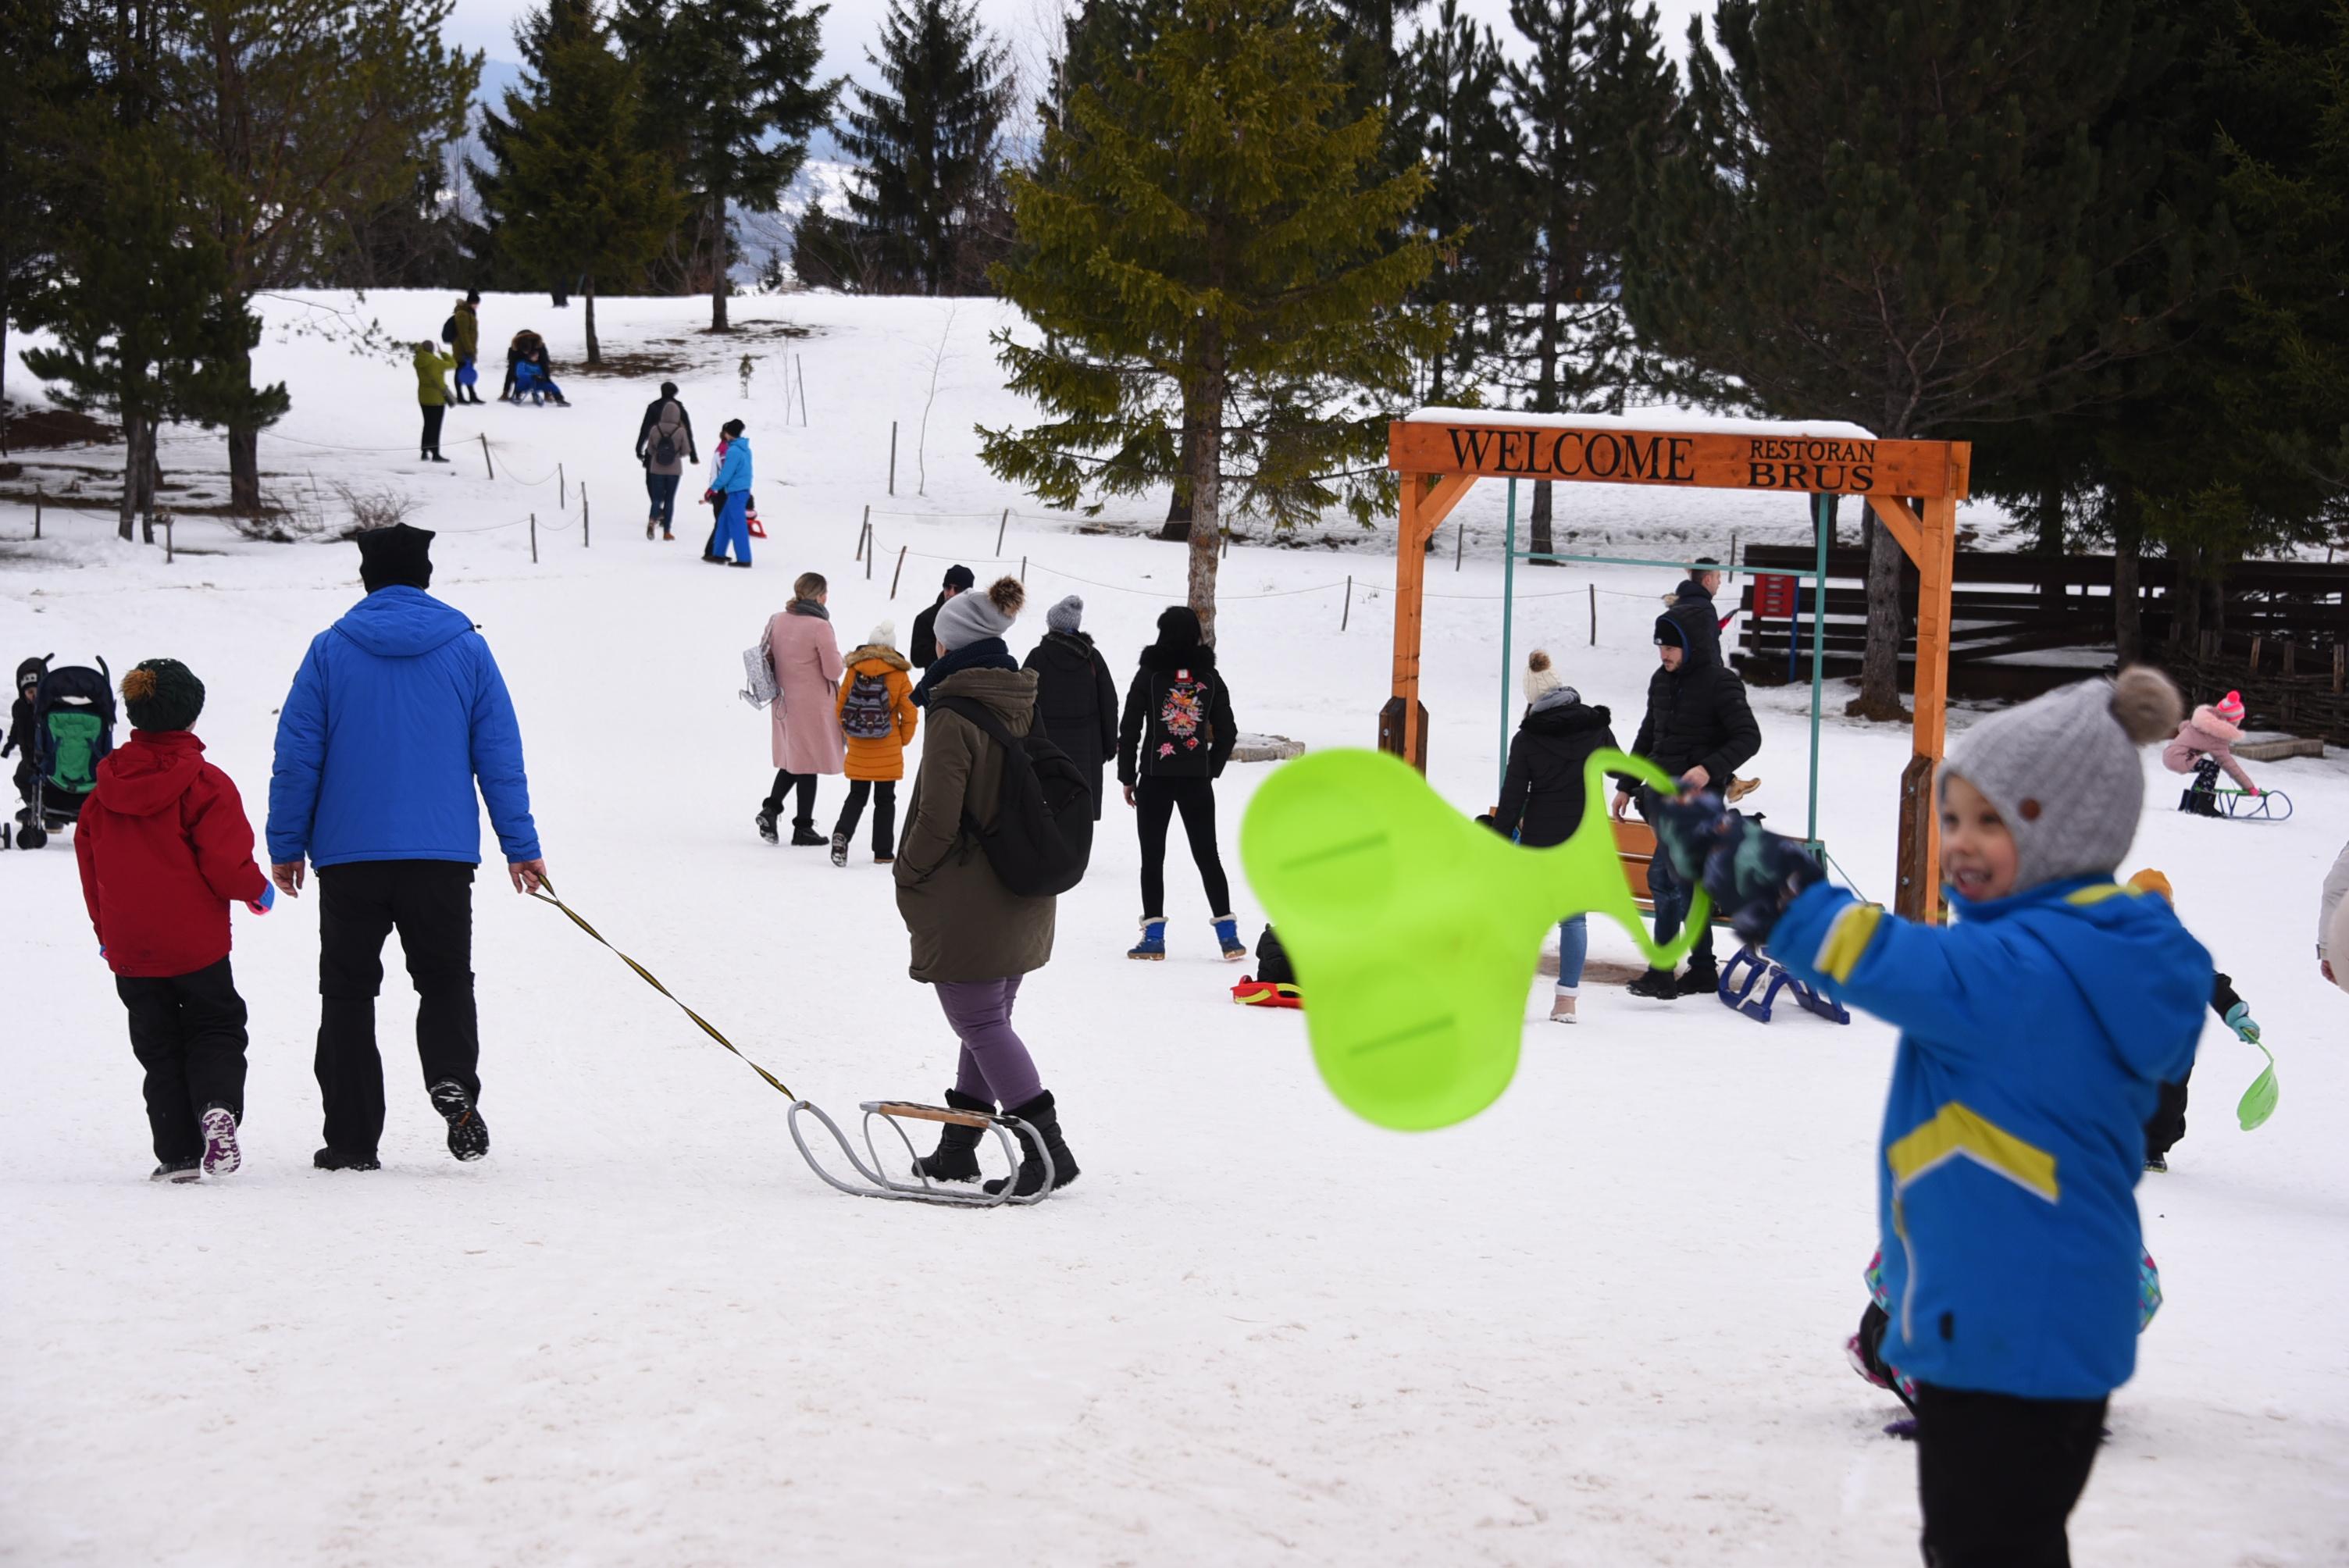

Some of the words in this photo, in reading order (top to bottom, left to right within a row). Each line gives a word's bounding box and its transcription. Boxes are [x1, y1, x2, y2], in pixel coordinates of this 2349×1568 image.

[1447, 428, 1695, 481] WELCOME
[1750, 440, 1876, 462] RESTORAN
[1748, 462, 1873, 491] BRUS
